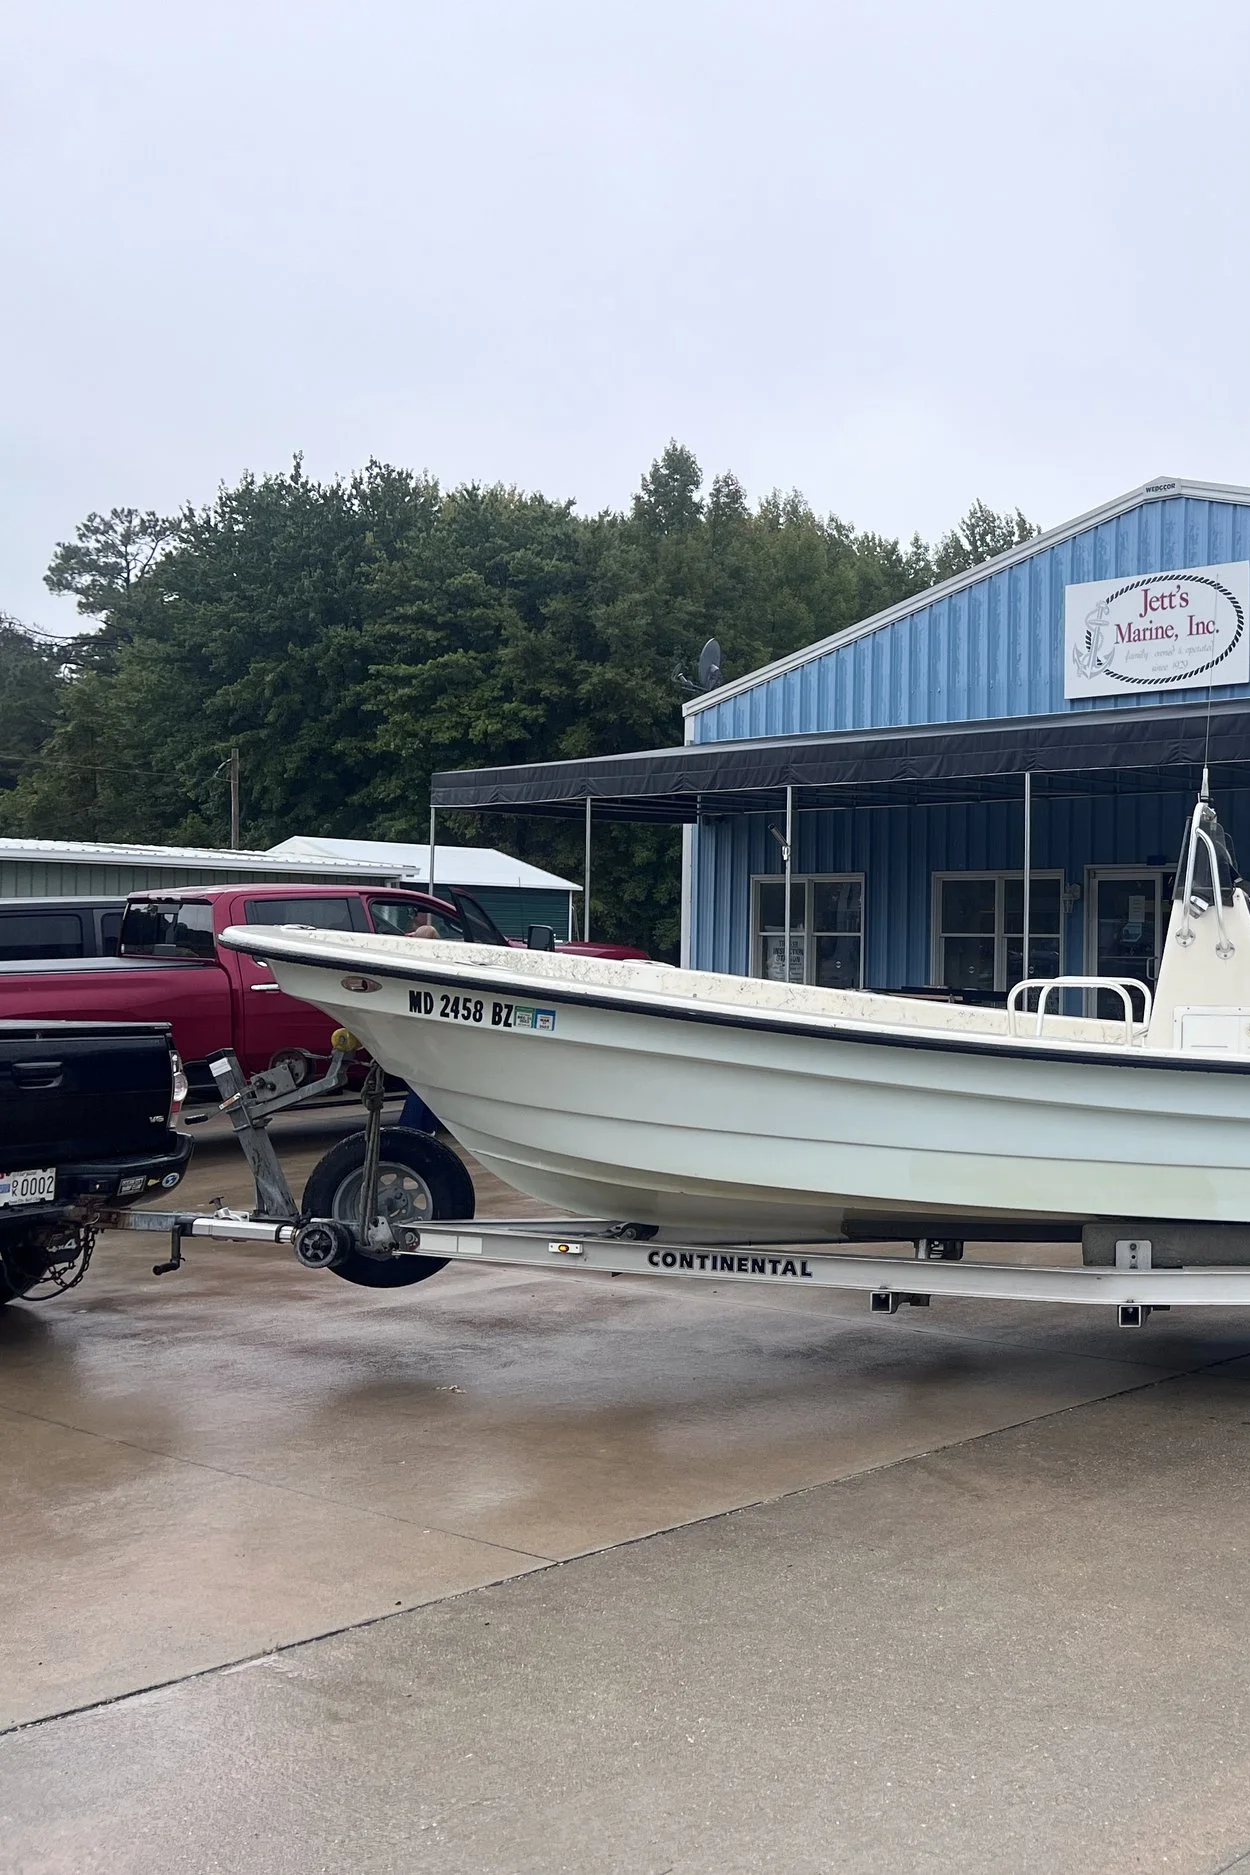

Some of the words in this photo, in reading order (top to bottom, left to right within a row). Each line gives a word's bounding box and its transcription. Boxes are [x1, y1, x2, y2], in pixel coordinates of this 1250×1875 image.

[1139, 584, 1190, 618] Jett's
[1114, 620, 1179, 645] Marine,
[1187, 615, 1220, 635] Inc.
[409, 990, 434, 1015] MD
[440, 994, 484, 1022] 2458
[491, 1001, 513, 1027] BZ
[647, 1251, 813, 1277] CONTINENTAL
